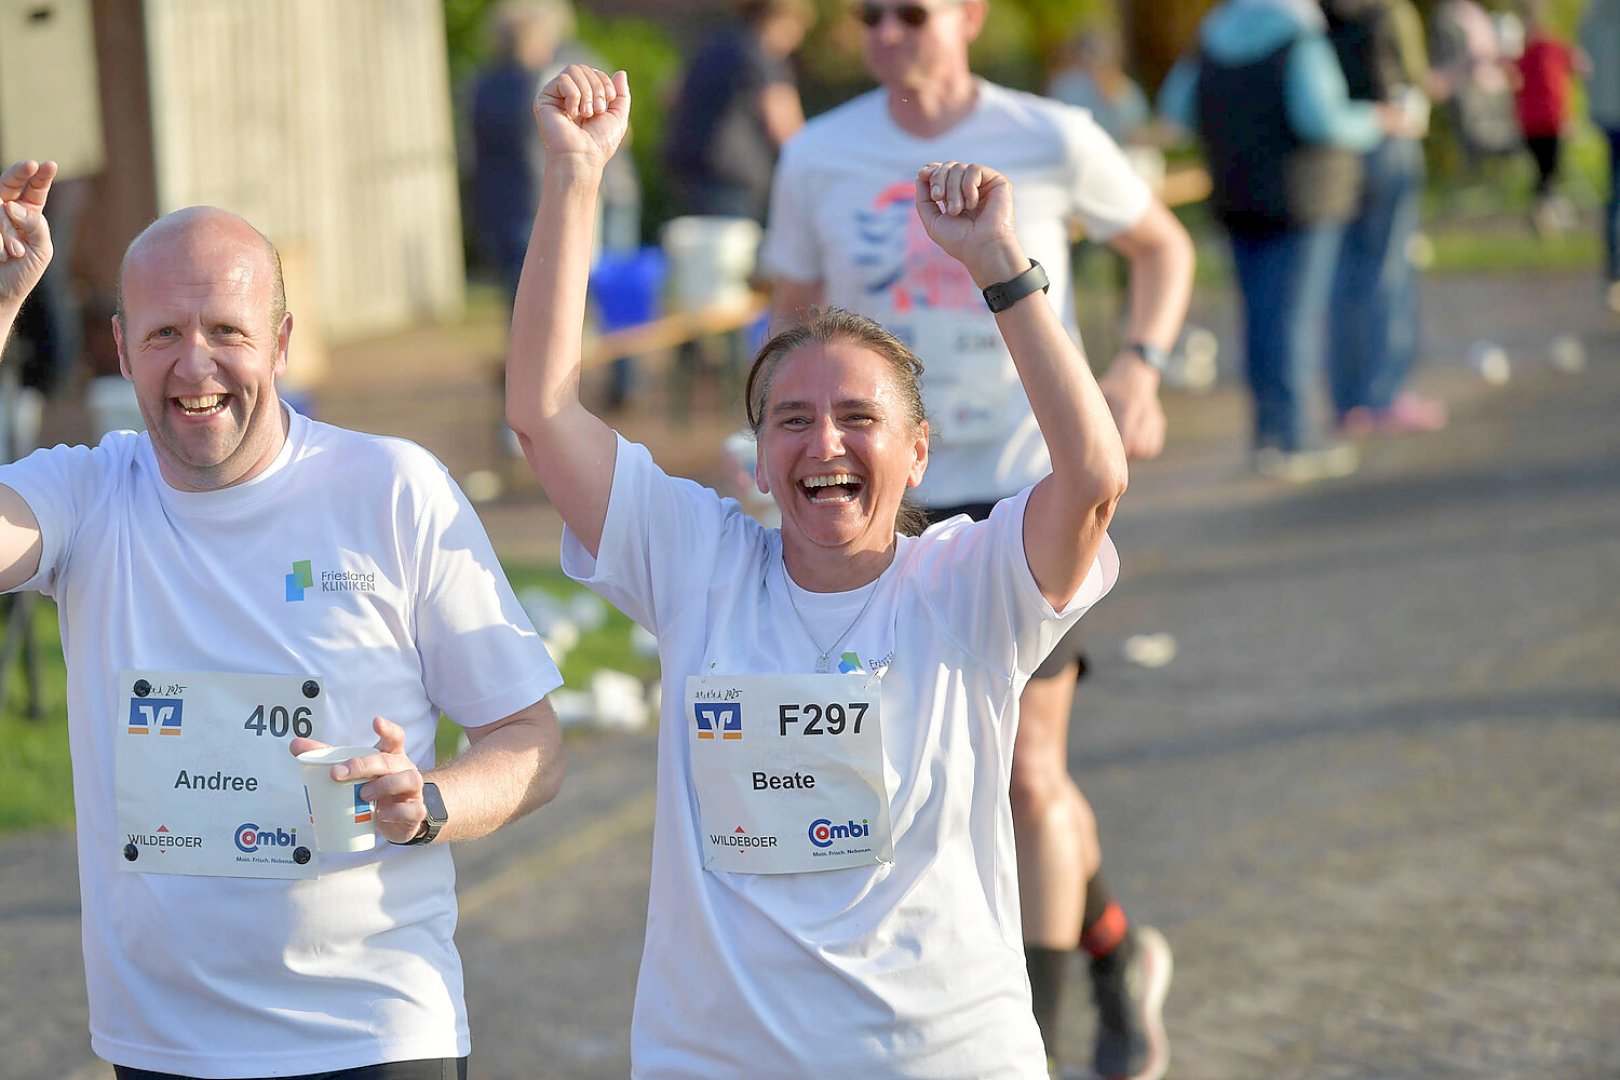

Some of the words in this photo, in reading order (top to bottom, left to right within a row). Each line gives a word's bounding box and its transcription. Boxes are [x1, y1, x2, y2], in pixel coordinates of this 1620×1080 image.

[321, 570, 375, 582] Friesland
[322, 581, 375, 592] KLINIKEN
[244, 704, 313, 738] 406
[779, 702, 870, 737] F297
[174, 769, 259, 792] Andree
[752, 771, 816, 791] Beate
[127, 834, 203, 849] WILDEBOER
[234, 822, 297, 853] Combi
[710, 834, 778, 848] WILDEBOER
[808, 818, 869, 848] Combi
